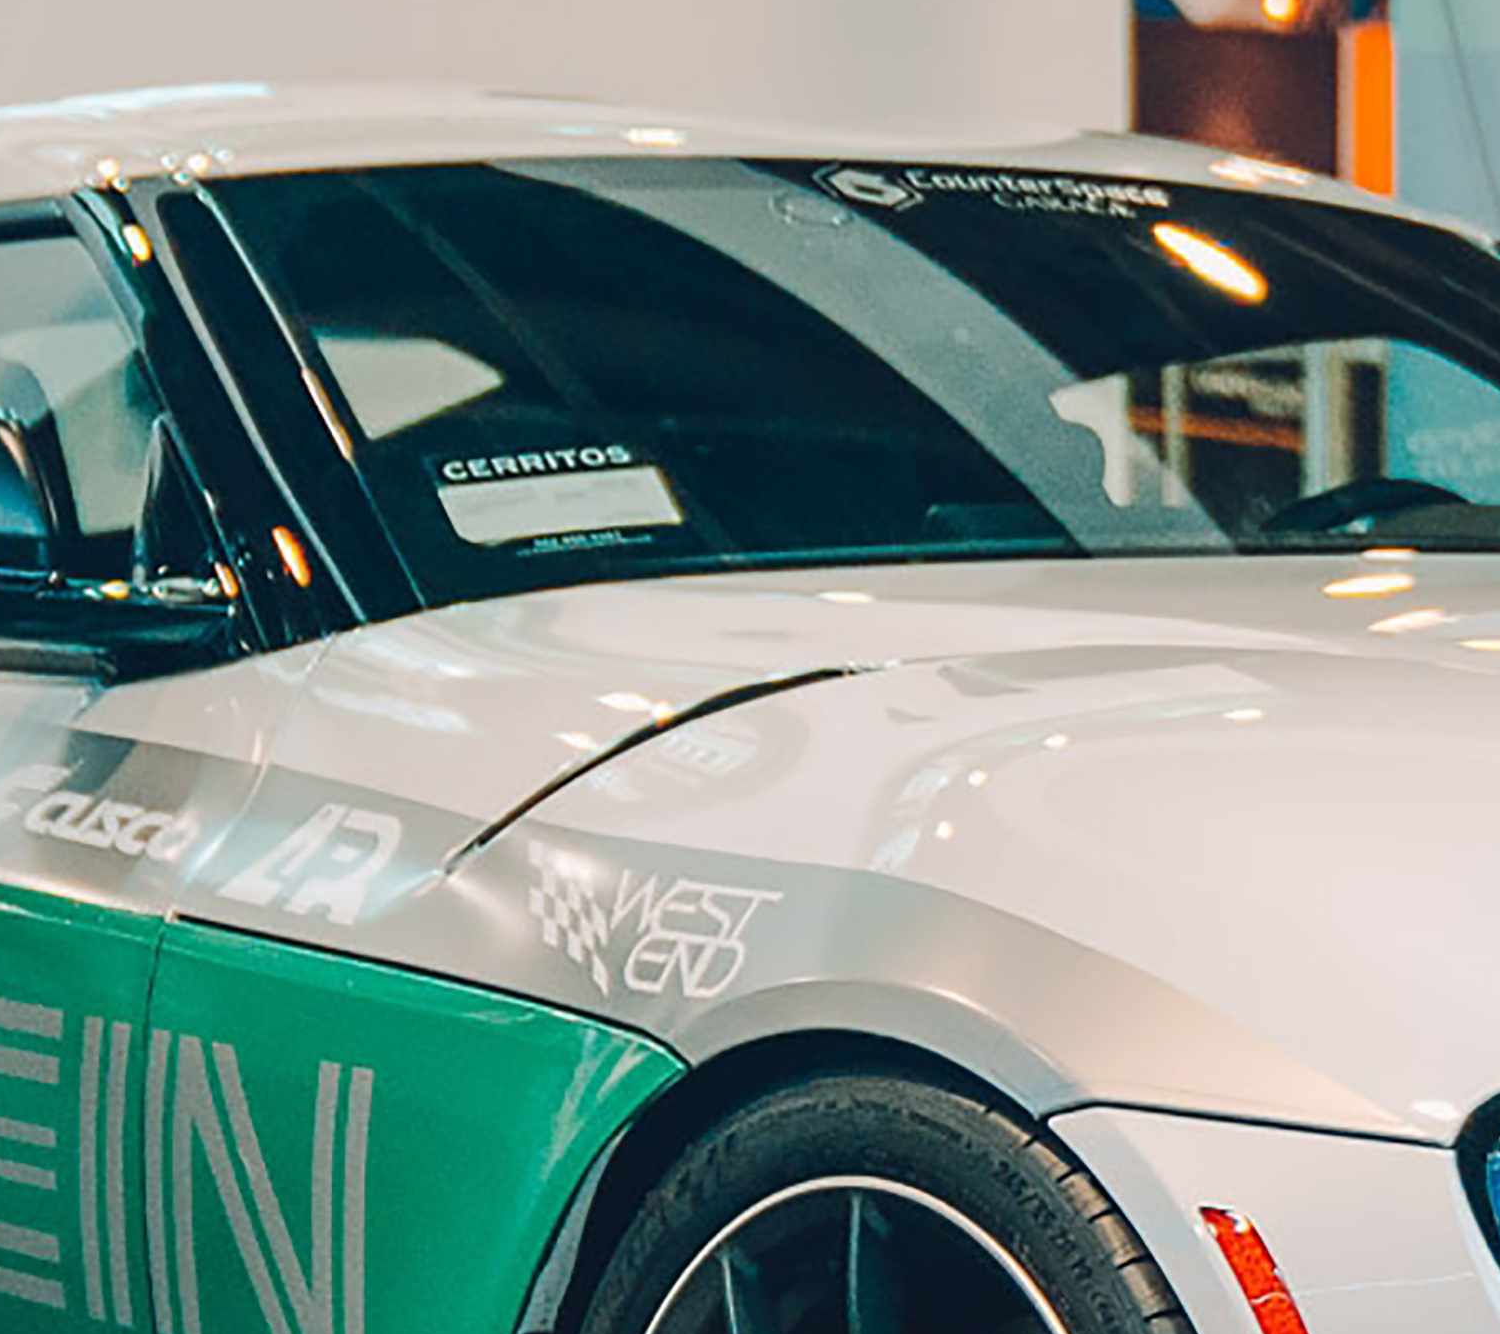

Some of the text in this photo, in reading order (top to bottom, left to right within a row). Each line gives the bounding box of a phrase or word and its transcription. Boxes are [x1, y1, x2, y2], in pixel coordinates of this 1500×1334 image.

[442, 444, 632, 481] CERRITOS
[609, 869, 784, 945] WEST
[622, 933, 746, 999] END
